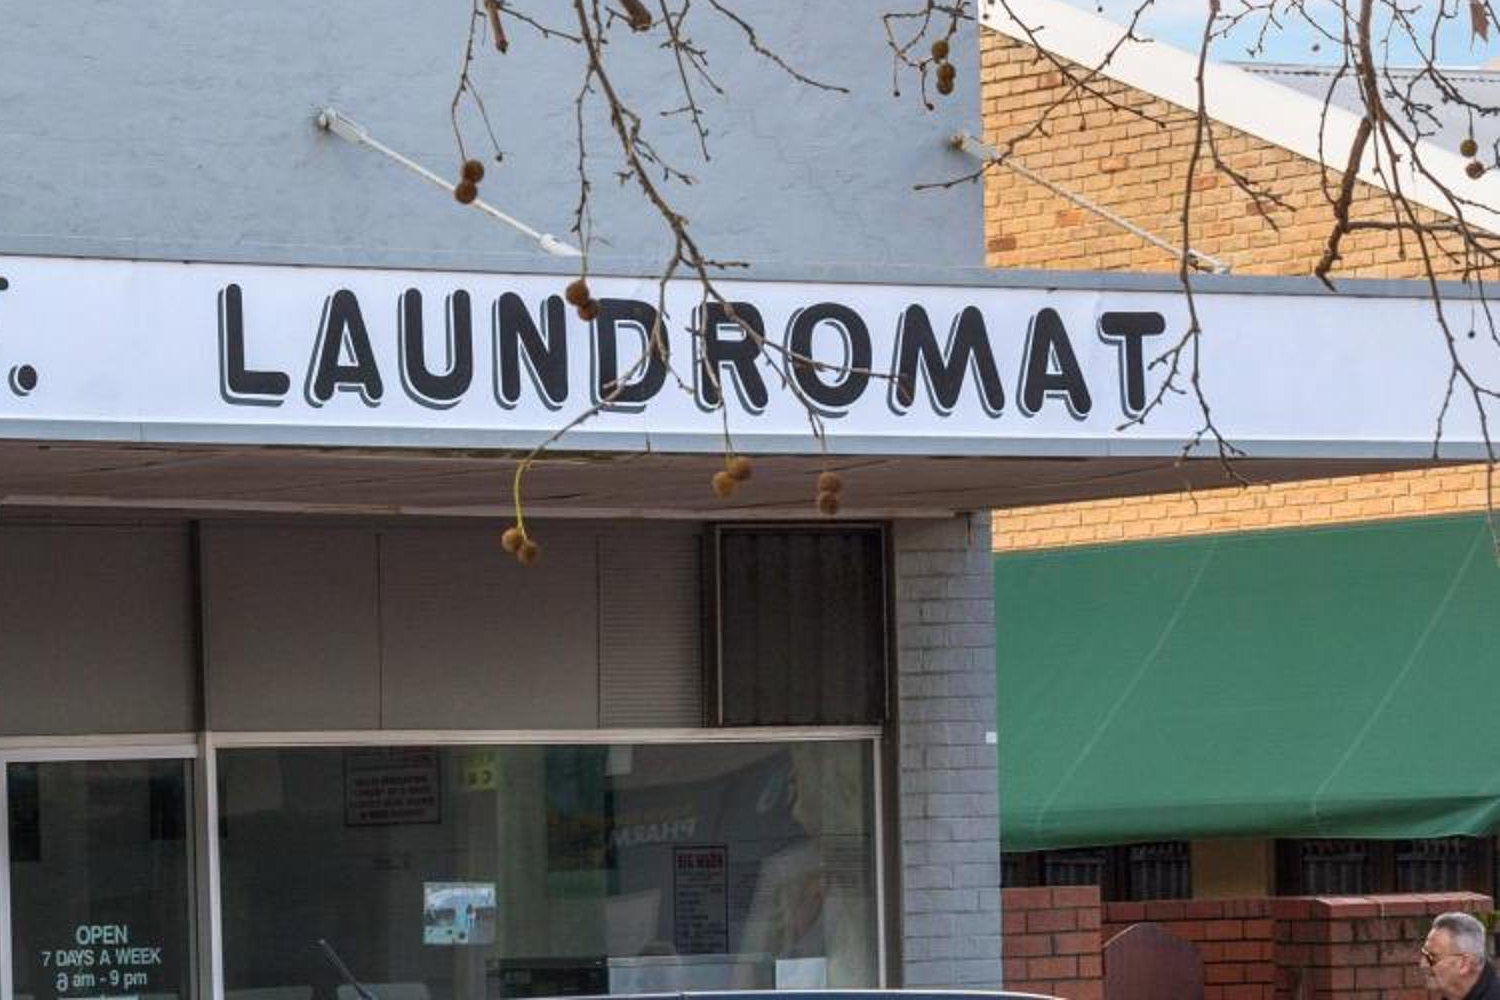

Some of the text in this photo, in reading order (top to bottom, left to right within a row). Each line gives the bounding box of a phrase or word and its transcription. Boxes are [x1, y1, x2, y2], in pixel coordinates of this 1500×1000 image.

[217, 283, 1165, 419] LAUNDROMAT
[76, 925, 128, 944] OPEN
[42, 948, 161, 967] 7 DAYS A WEEK
[72, 974, 95, 987] am
[109, 969, 120, 986] 9
[124, 973, 148, 990] pm
